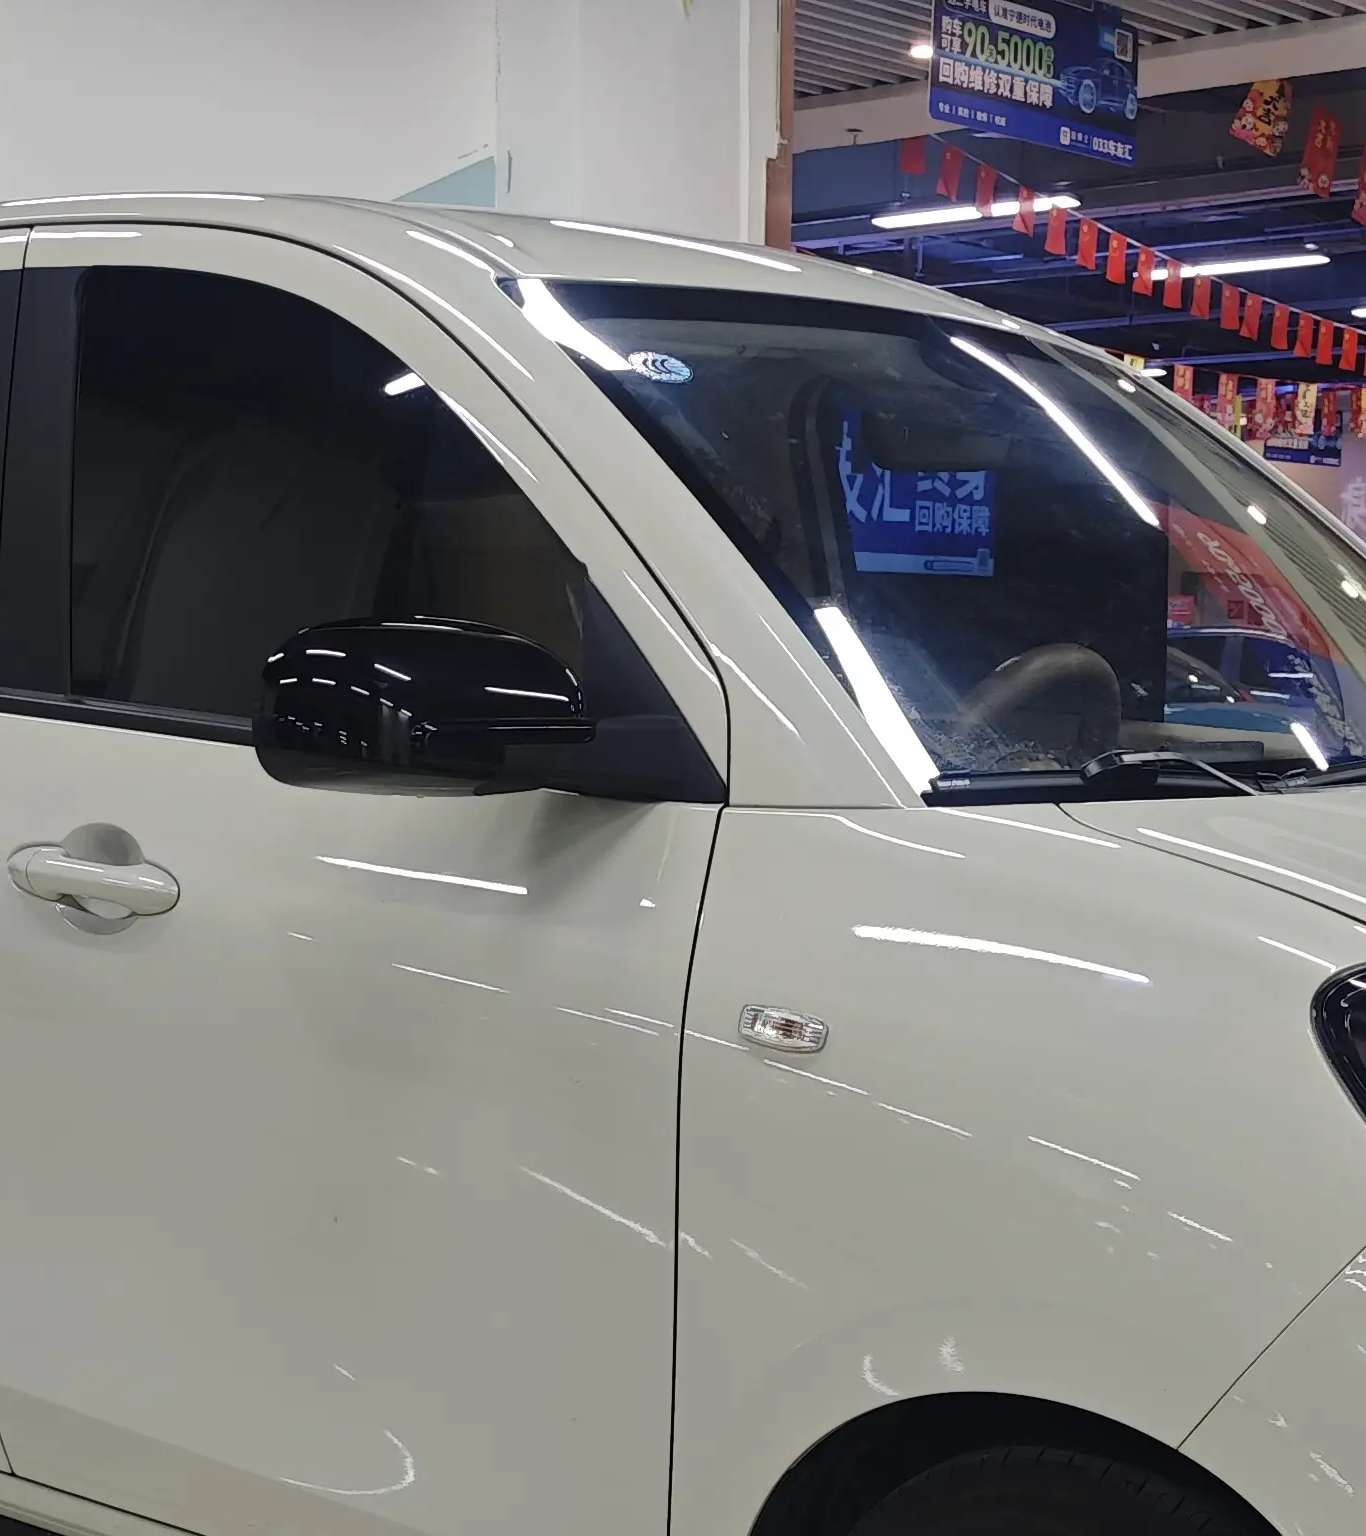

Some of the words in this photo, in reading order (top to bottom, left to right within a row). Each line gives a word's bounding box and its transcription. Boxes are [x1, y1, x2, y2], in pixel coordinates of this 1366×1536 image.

[939, 57, 1054, 109] 回购维修双重保障
[915, 500, 990, 536] 回购保障
